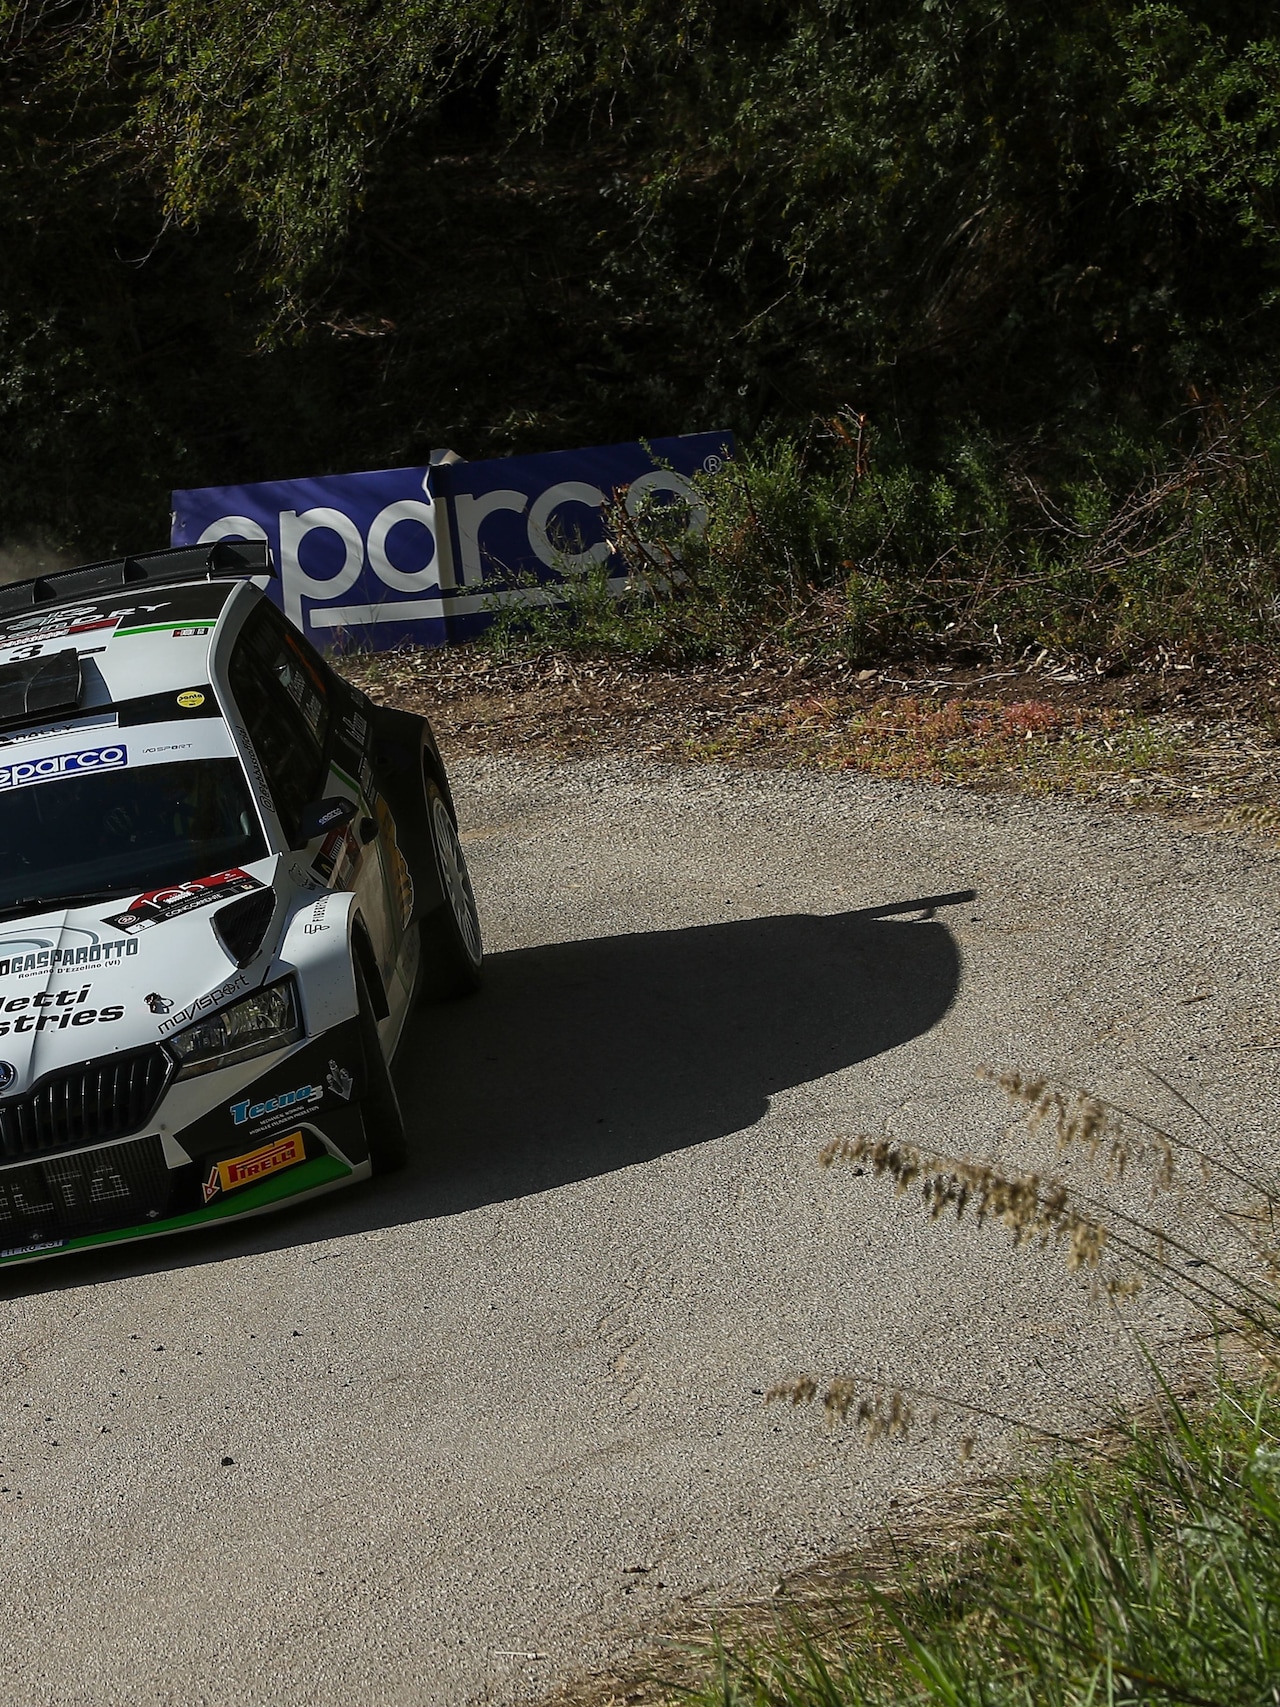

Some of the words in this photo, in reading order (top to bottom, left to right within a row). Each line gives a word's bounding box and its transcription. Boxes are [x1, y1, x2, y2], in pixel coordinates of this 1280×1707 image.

[18, 968, 54, 980] Romano
[57, 963, 102, 975] D'Ezzelino
[227, 1140, 297, 1184] PIRELLI
